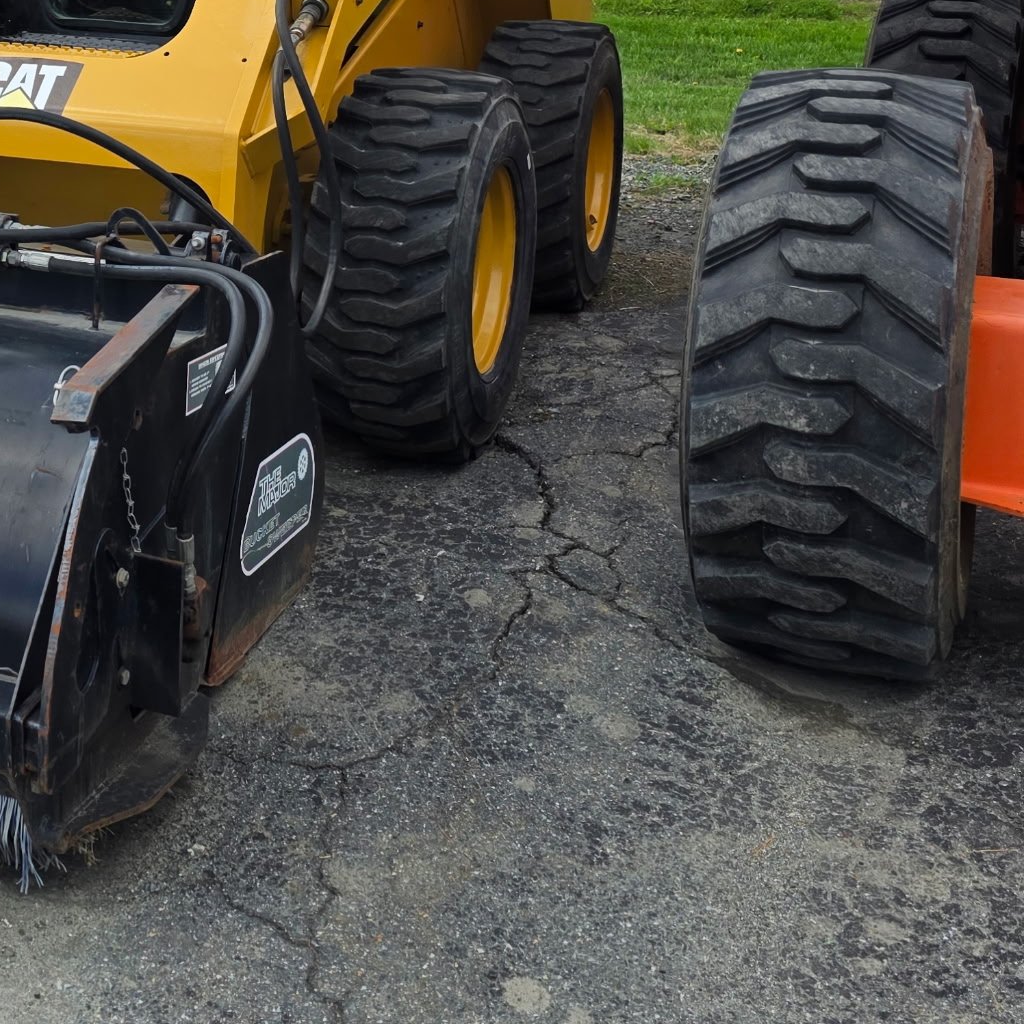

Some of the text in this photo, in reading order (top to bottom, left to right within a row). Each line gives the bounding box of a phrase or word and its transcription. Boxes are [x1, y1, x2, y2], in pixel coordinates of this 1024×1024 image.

[257, 471, 297, 517] MAJOR
[258, 464, 282, 496] THE
[243, 512, 281, 553] BUCKET
